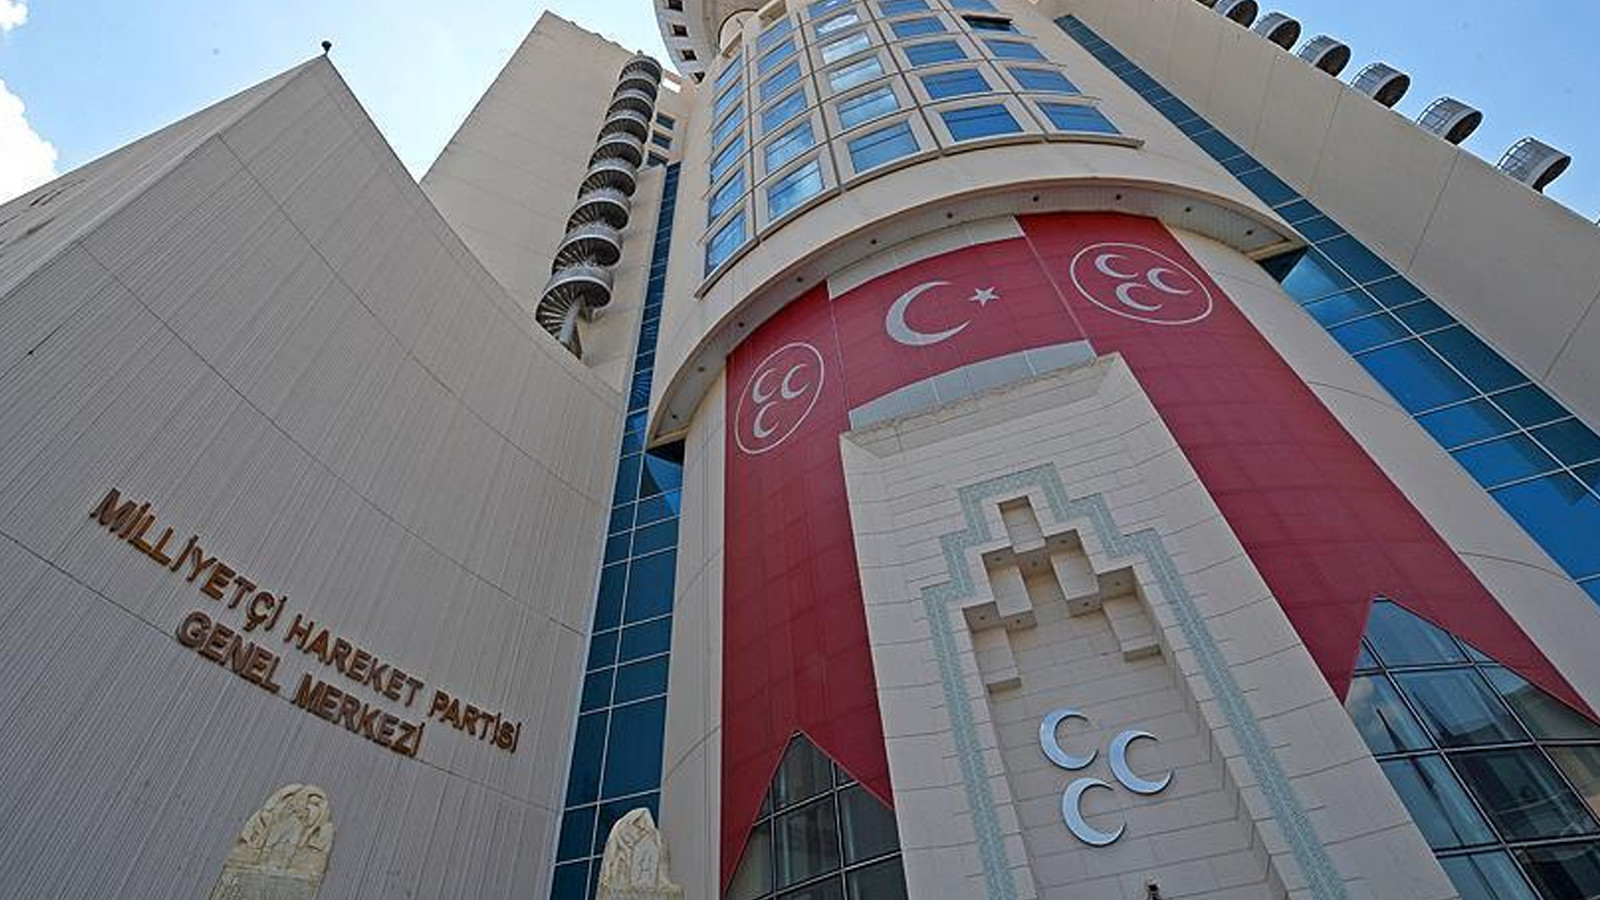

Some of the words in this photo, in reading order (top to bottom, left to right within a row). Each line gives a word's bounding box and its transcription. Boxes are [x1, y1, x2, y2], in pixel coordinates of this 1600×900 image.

[89, 488, 287, 632] MİLLİYETÇİ
[284, 613, 424, 707] HAREKET
[428, 689, 522, 753] PARTİSİ
[176, 611, 282, 694] GENEL
[291, 673, 426, 757] MERKEZİ
